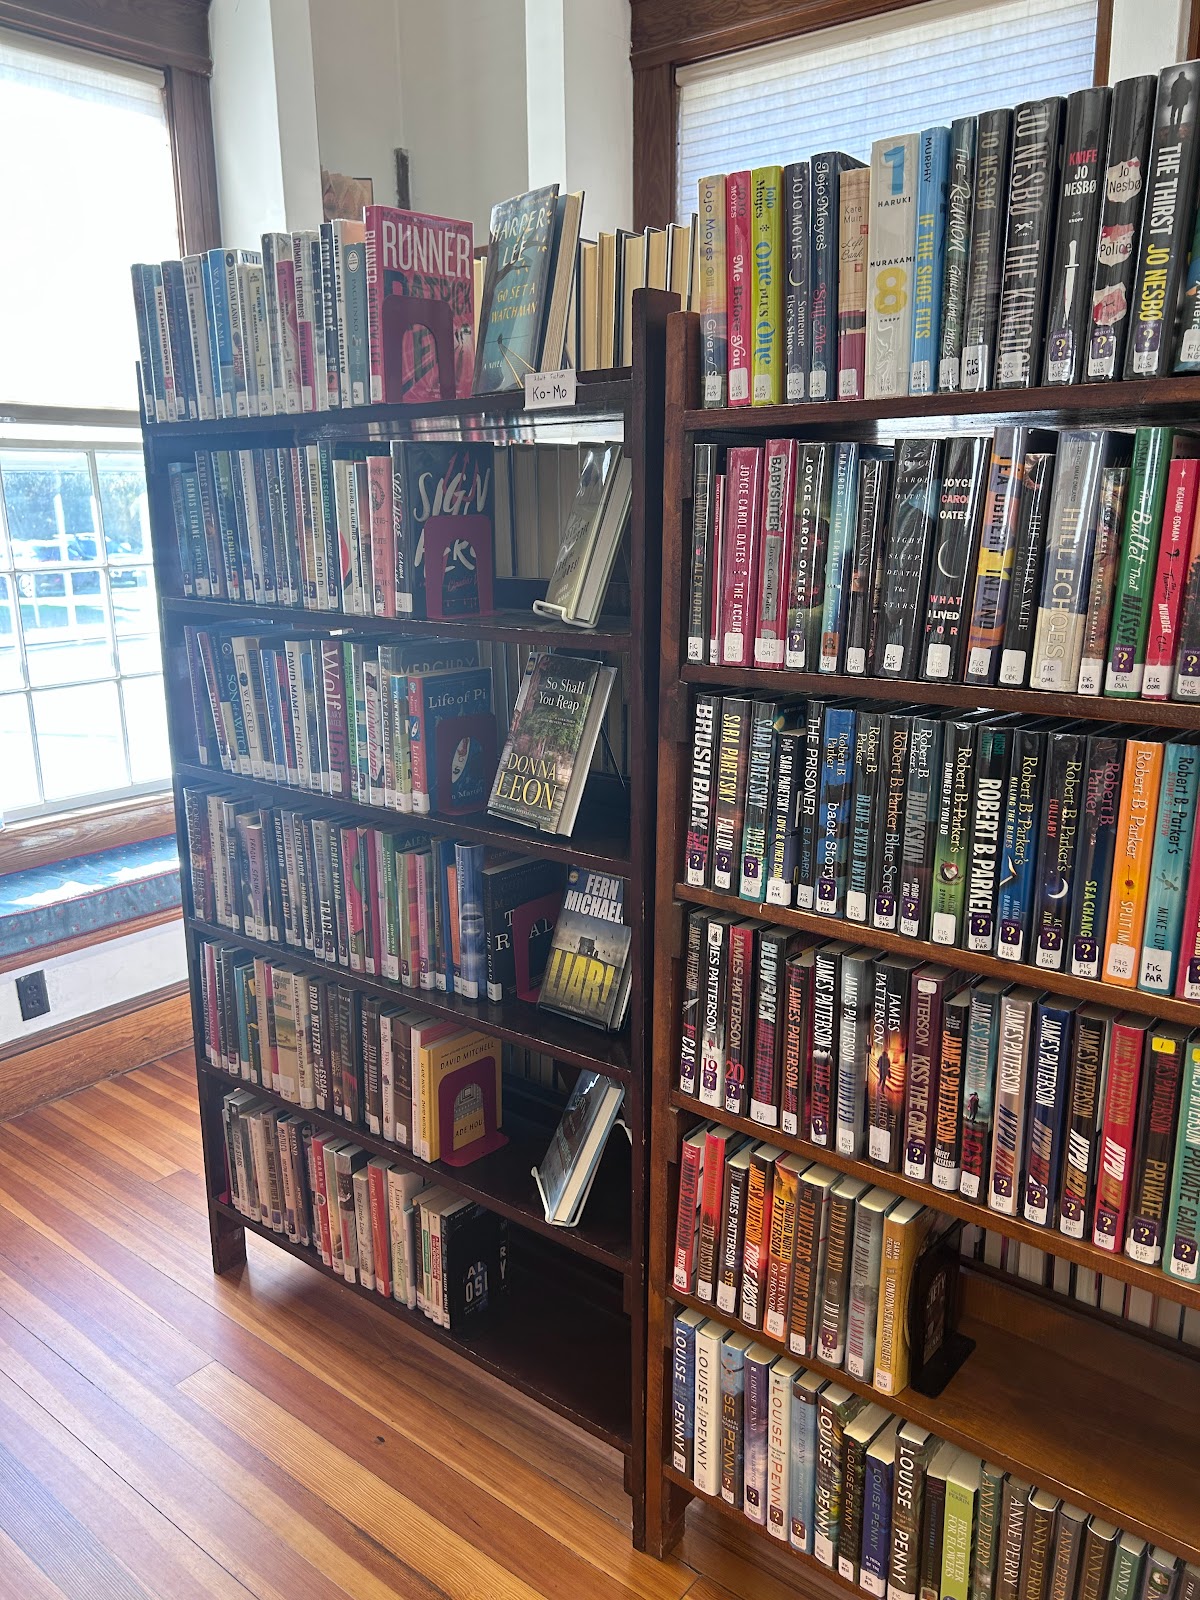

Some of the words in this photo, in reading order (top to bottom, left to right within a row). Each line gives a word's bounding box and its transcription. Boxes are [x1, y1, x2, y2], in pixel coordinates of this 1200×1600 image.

[923, 137, 932, 184] MURPHY
[1069, 148, 1098, 166] KNIFE
[1074, 165, 1089, 180] JO
[1118, 164, 1130, 178] Jo
[1155, 142, 1182, 177] THE
[704, 184, 716, 213] Jojo
[754, 180, 765, 219] Moyes
[766, 186, 777, 209] Jojo
[792, 177, 803, 210] JOJO
[877, 196, 912, 208] HARUKI
[1149, 179, 1179, 235] THIRST
[491, 208, 546, 243] HARPER
[792, 214, 802, 261] MOYES
[920, 214, 935, 226] IF
[292, 238, 301, 272] CRIMINAL
[365, 230, 377, 283] RUNNER
[382, 221, 470, 279] RUNNER
[503, 243, 526, 267] LEE
[704, 216, 716, 262] Moyes
[918, 228, 934, 260] THE
[1100, 241, 1133, 258] Police
[1145, 243, 1171, 264] JO
[227, 270, 236, 301] WILLIAM
[295, 277, 305, 319] ENTERPRISE
[497, 289, 508, 302] GO
[511, 286, 529, 300] SET
[530, 283, 535, 293] A
[916, 263, 933, 303] SHOE
[1139, 267, 1168, 322] NESBØ
[230, 303, 239, 329] LANDAY
[491, 302, 536, 323] WATCHMAN
[798, 300, 807, 347] Someone
[915, 305, 931, 340] FITS
[533, 384, 567, 400] Ko-Mo
[837, 453, 846, 496] HAZARDS
[1135, 439, 1149, 477] OSMAN
[186, 478, 196, 507] DENNIS
[414, 468, 491, 522] SIGN
[739, 464, 750, 495] JOYCE
[768, 456, 782, 532] BABYSITTER
[804, 456, 814, 502] JOYCE
[737, 496, 748, 525] CAROL
[1175, 486, 1185, 515] RICHARD
[190, 509, 199, 539] LEHANE
[801, 507, 811, 554] CAROL
[834, 512, 843, 534] TIME
[1171, 516, 1182, 541] OSMAN
[735, 528, 746, 564] OATES
[832, 537, 841, 574] TRAVEL
[733, 582, 744, 601] THE
[797, 559, 807, 602] OATES
[288, 652, 296, 681] DAVID
[323, 649, 342, 711] Wolf
[290, 684, 300, 721] MAMET
[428, 695, 455, 709] Life
[457, 693, 470, 704] of
[474, 689, 486, 700] Pi
[538, 692, 554, 706] You
[556, 694, 580, 713] Reap
[545, 676, 558, 690] So
[560, 679, 585, 694] Shall
[244, 690, 254, 733] WICKED
[295, 726, 304, 768] CHICAGO
[694, 703, 714, 776] BRUSH
[722, 714, 741, 745] SARA
[752, 718, 773, 749] SARA
[806, 717, 821, 745] THE
[329, 729, 345, 772] Hall
[412, 744, 420, 766] Life
[779, 754, 793, 770] SARA
[855, 732, 868, 765] Parker
[507, 753, 557, 781] DONNA
[718, 746, 739, 805] PARETSKY
[748, 751, 770, 810] PARETSKY
[802, 748, 819, 816] PRISONER
[496, 771, 559, 810] LEON
[690, 777, 710, 829] BACK
[776, 771, 792, 813] PARETSKY
[1008, 777, 1019, 807] KILLING
[1007, 807, 1016, 823] THE
[1047, 798, 1060, 838] LULLABY
[250, 838, 258, 867] PRAGUE
[329, 836, 338, 871] ARCHER
[1006, 825, 1014, 849] BLUES
[251, 868, 261, 895] SPRING
[332, 873, 341, 900] MAYOR
[584, 874, 620, 899] FERN
[320, 900, 333, 936] TRACE
[563, 890, 624, 925] MICHAEL
[1119, 900, 1134, 930] SPLIT
[551, 949, 616, 1008] LIAR!
[758, 940, 779, 1024] BLOWBACK
[816, 955, 835, 996] JAMES
[1145, 971, 1164, 983] PAR
[1147, 962, 1162, 973] FIC
[309, 985, 318, 1011] BRAD
[705, 969, 720, 1034] PATTERSON
[788, 984, 802, 1024] JAMES
[844, 972, 858, 1007] JAMES
[814, 995, 834, 1050] PATTERSON
[873, 972, 888, 1046] PATTERSON
[887, 993, 902, 1033] JAMES
[311, 1016, 321, 1055] MELTZER
[839, 1008, 857, 1064] PATTERSON
[440, 1056, 462, 1070] DAVID
[463, 1041, 494, 1061] MITCHELL
[785, 1025, 801, 1089] PATTERSON
[320, 1069, 329, 1099] ESCAPE
[837, 1069, 857, 1124] HAUNTED
[749, 1162, 765, 1197] JAMES
[1140, 1158, 1168, 1219] PRIVATE
[730, 1183, 741, 1214] JAMES
[747, 1198, 764, 1244] PATTERSON
[770, 1195, 784, 1258] PATTERSON
[725, 1215, 739, 1268] PATTERSON
[884, 1277, 896, 1311] LONDON
[882, 1310, 894, 1338] SEANCE
[674, 1328, 687, 1384] LOUISE
[881, 1337, 892, 1369] SOCIETY
[697, 1347, 709, 1404] LOUISE
[673, 1400, 686, 1452] PENNY
[979, 1475, 996, 1520] ANNE
[948, 1513, 957, 1532] FOR
[956, 1519, 967, 1548] FRESH
[945, 1534, 956, 1578] FLOWERS
[977, 1522, 994, 1569] PERRY
[955, 1548, 966, 1583] WATER
